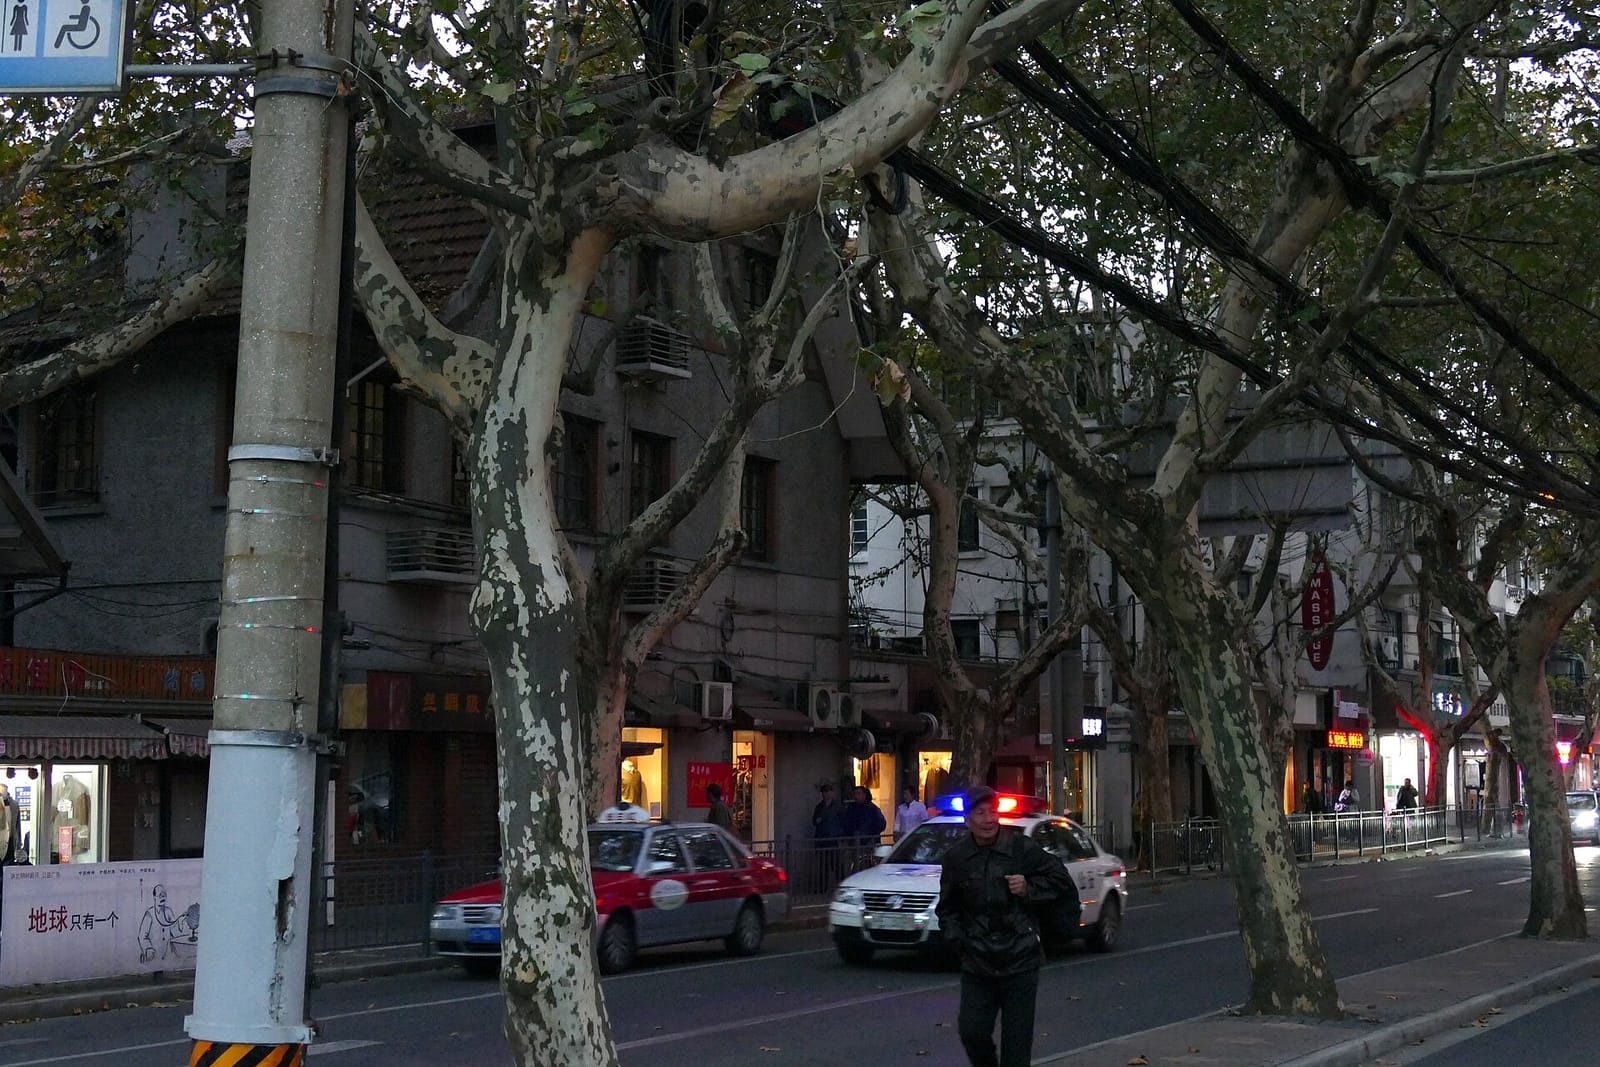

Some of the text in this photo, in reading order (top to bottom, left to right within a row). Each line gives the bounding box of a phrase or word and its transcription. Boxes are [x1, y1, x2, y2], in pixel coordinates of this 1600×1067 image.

[1310, 578, 1321, 662] MASSGE
[28, 905, 119, 934] 地球只有一个
